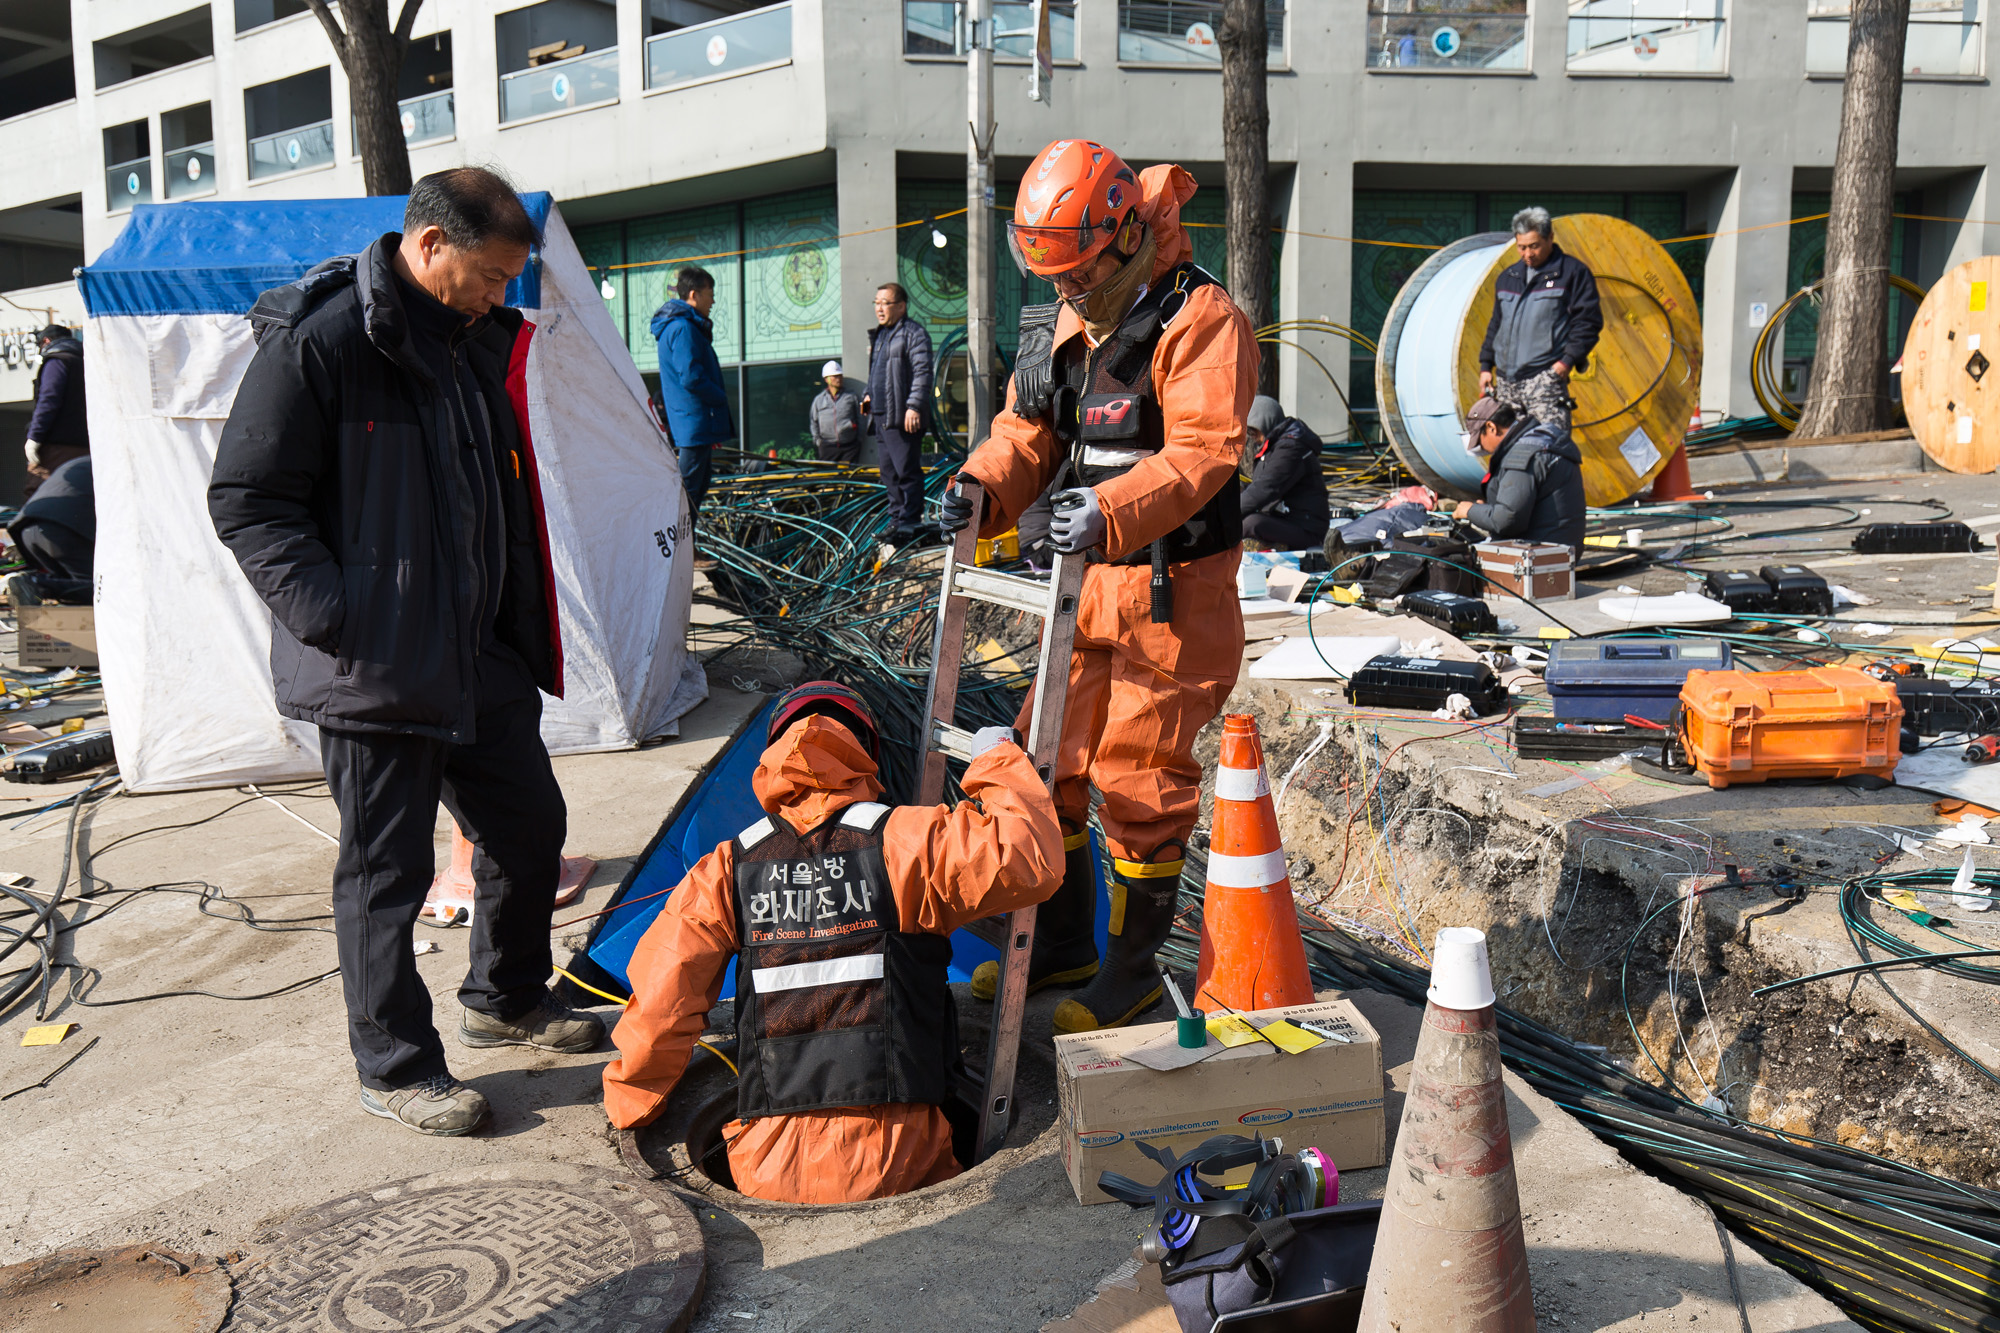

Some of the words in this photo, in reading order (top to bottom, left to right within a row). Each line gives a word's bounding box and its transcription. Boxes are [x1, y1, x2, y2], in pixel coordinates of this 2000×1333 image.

[1085, 398, 1132, 426] 119
[750, 879, 872, 924] 화재조사
[752, 930, 774, 942] Fire
[776, 927, 806, 940] Scene
[809, 918, 878, 938] Investigation
[1129, 1118, 1220, 1138] www.suniltelecom.com
[1241, 1114, 1262, 1125] SUNIL
[1261, 1111, 1288, 1123] Telecom
[1091, 1133, 1119, 1144] Telecom
